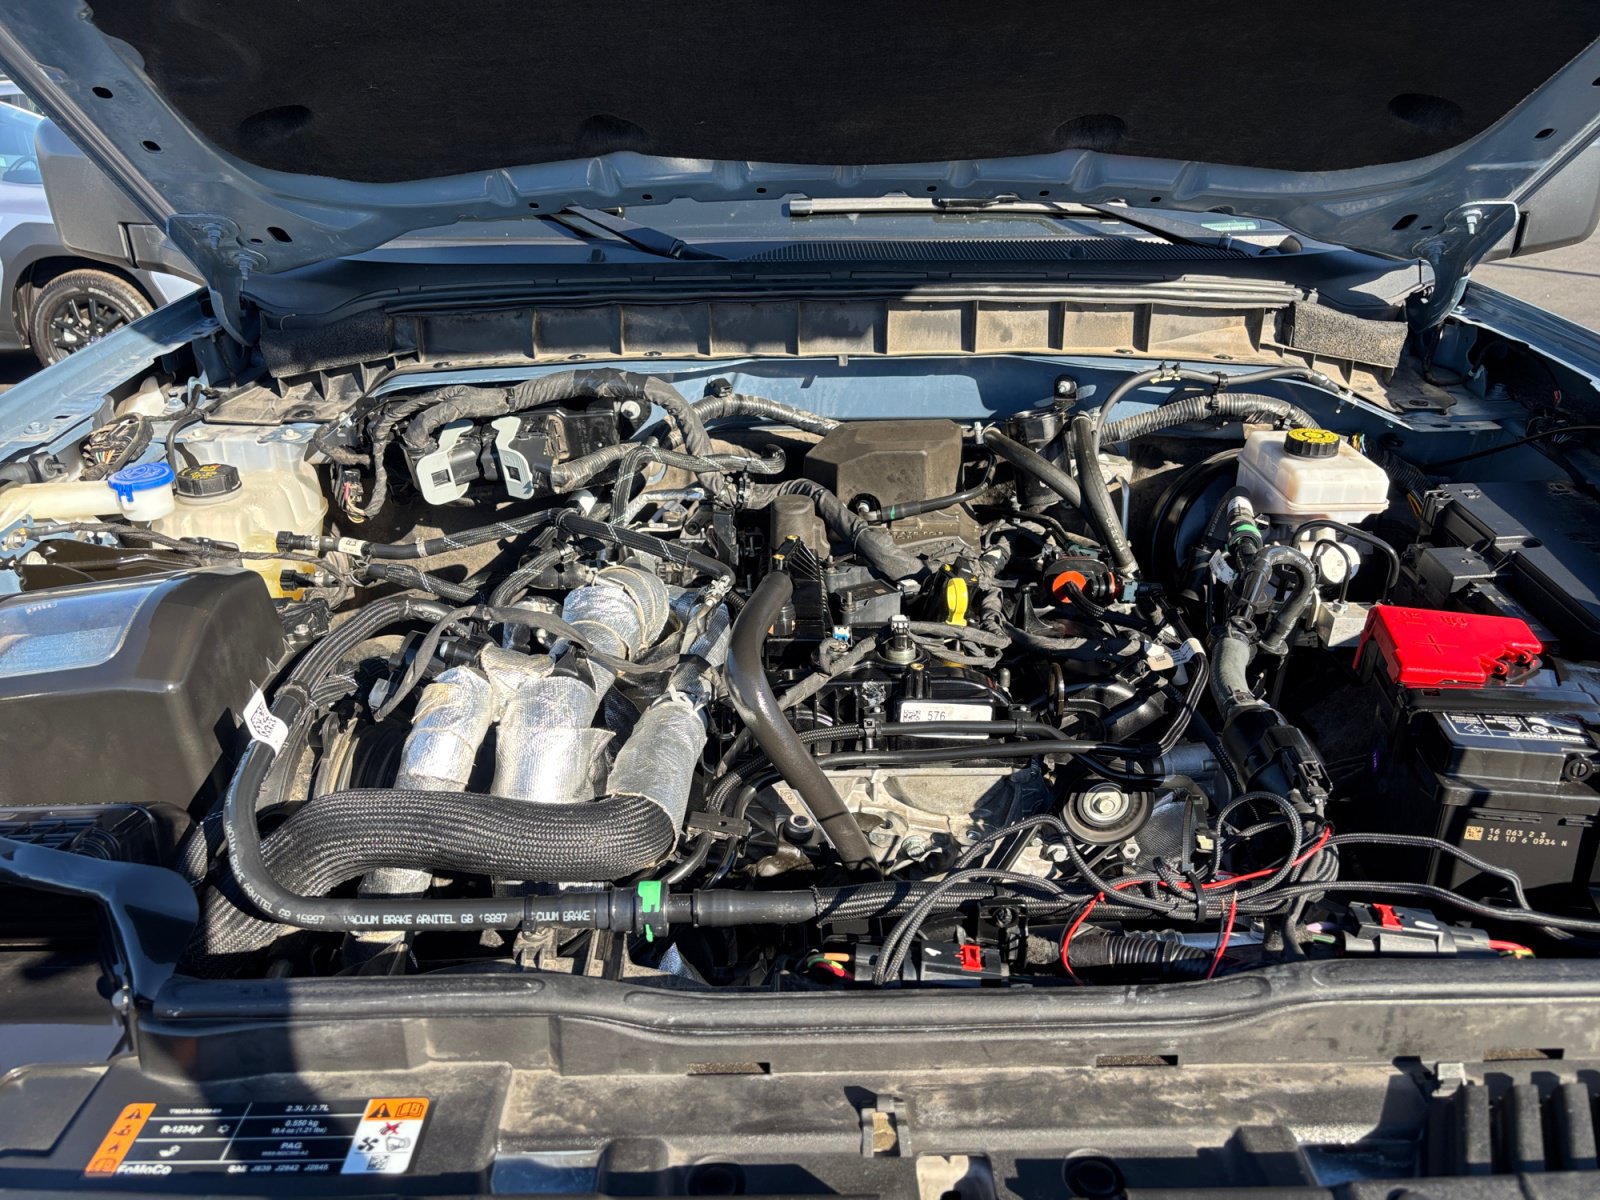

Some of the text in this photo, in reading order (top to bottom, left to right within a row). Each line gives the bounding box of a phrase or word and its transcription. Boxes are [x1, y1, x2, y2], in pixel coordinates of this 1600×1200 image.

[928, 710, 946, 721] 576
[1505, 829, 1524, 837] 063
[1487, 834, 1499, 842] 26
[1533, 838, 1556, 846] 0934
[383, 914, 412, 924] BRAKE
[416, 914, 456, 924] ARNITEL
[479, 913, 508, 922] 16897
[562, 910, 591, 922] BRAKE
[160, 1124, 204, 1134] R-1234yf
[116, 1164, 173, 1175] FoMoCo
